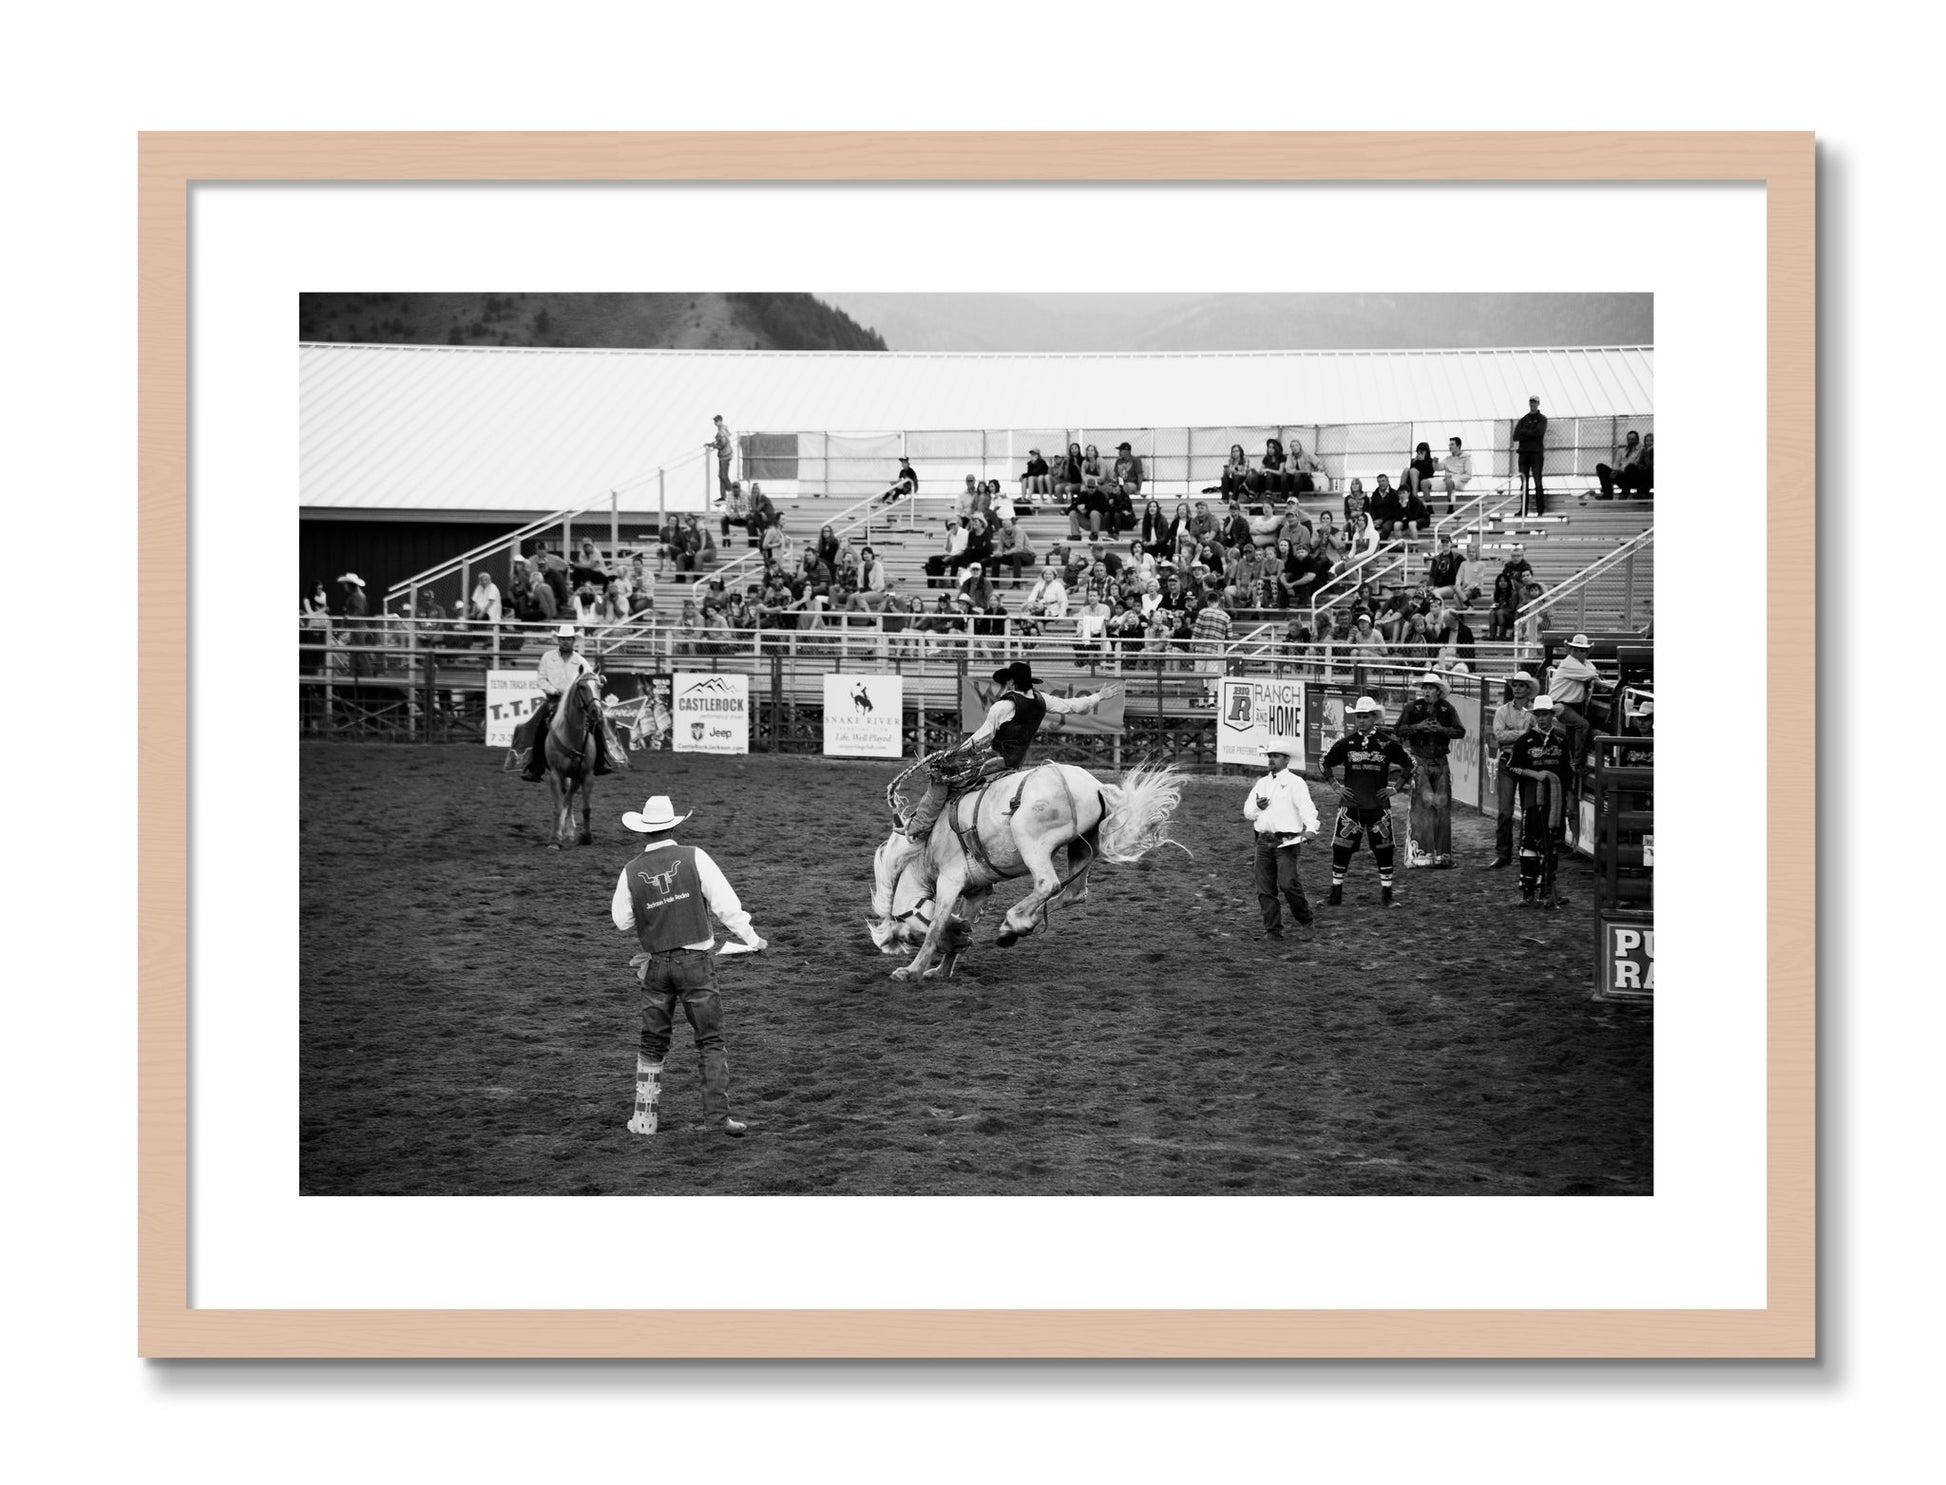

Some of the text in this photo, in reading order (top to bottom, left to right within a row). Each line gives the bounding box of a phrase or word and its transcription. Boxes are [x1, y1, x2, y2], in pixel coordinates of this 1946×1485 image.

[490, 680, 507, 689] TETON
[1233, 686, 1250, 696] BIG
[1255, 684, 1300, 704] RANCH
[678, 698, 744, 712] CASTLEROCK
[974, 681, 1099, 731] Wgle
[1228, 696, 1252, 722] R
[826, 716, 900, 725] SNAKE RIVER
[1256, 705, 1300, 737] AND HOME
[710, 728, 732, 738] Jeep
[646, 900, 664, 910] Jackson
[674, 892, 690, 900] Rodeo
